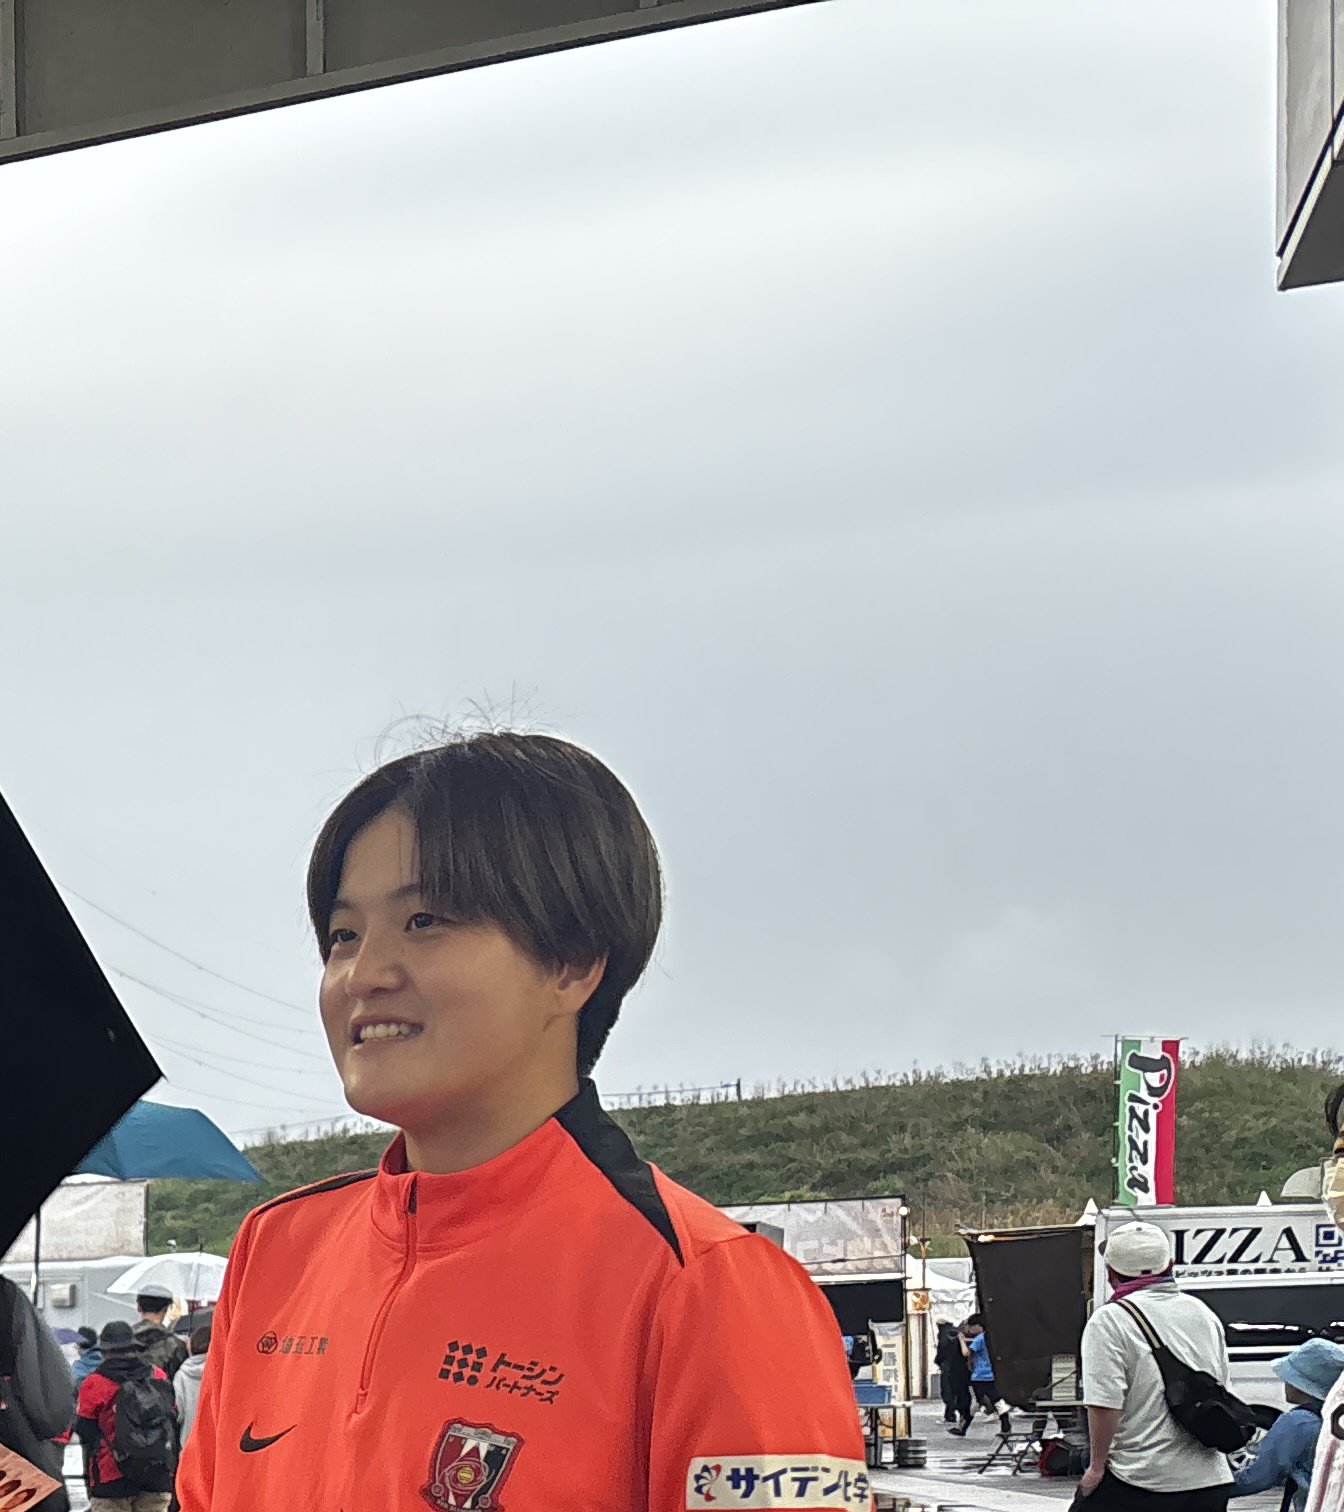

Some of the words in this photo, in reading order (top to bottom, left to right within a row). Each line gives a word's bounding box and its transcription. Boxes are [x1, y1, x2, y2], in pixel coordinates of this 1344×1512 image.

[1125, 1051, 1174, 1195] Pizza
[1170, 1226, 1311, 1266] IZZA
[490, 1352, 565, 1386] トーシン
